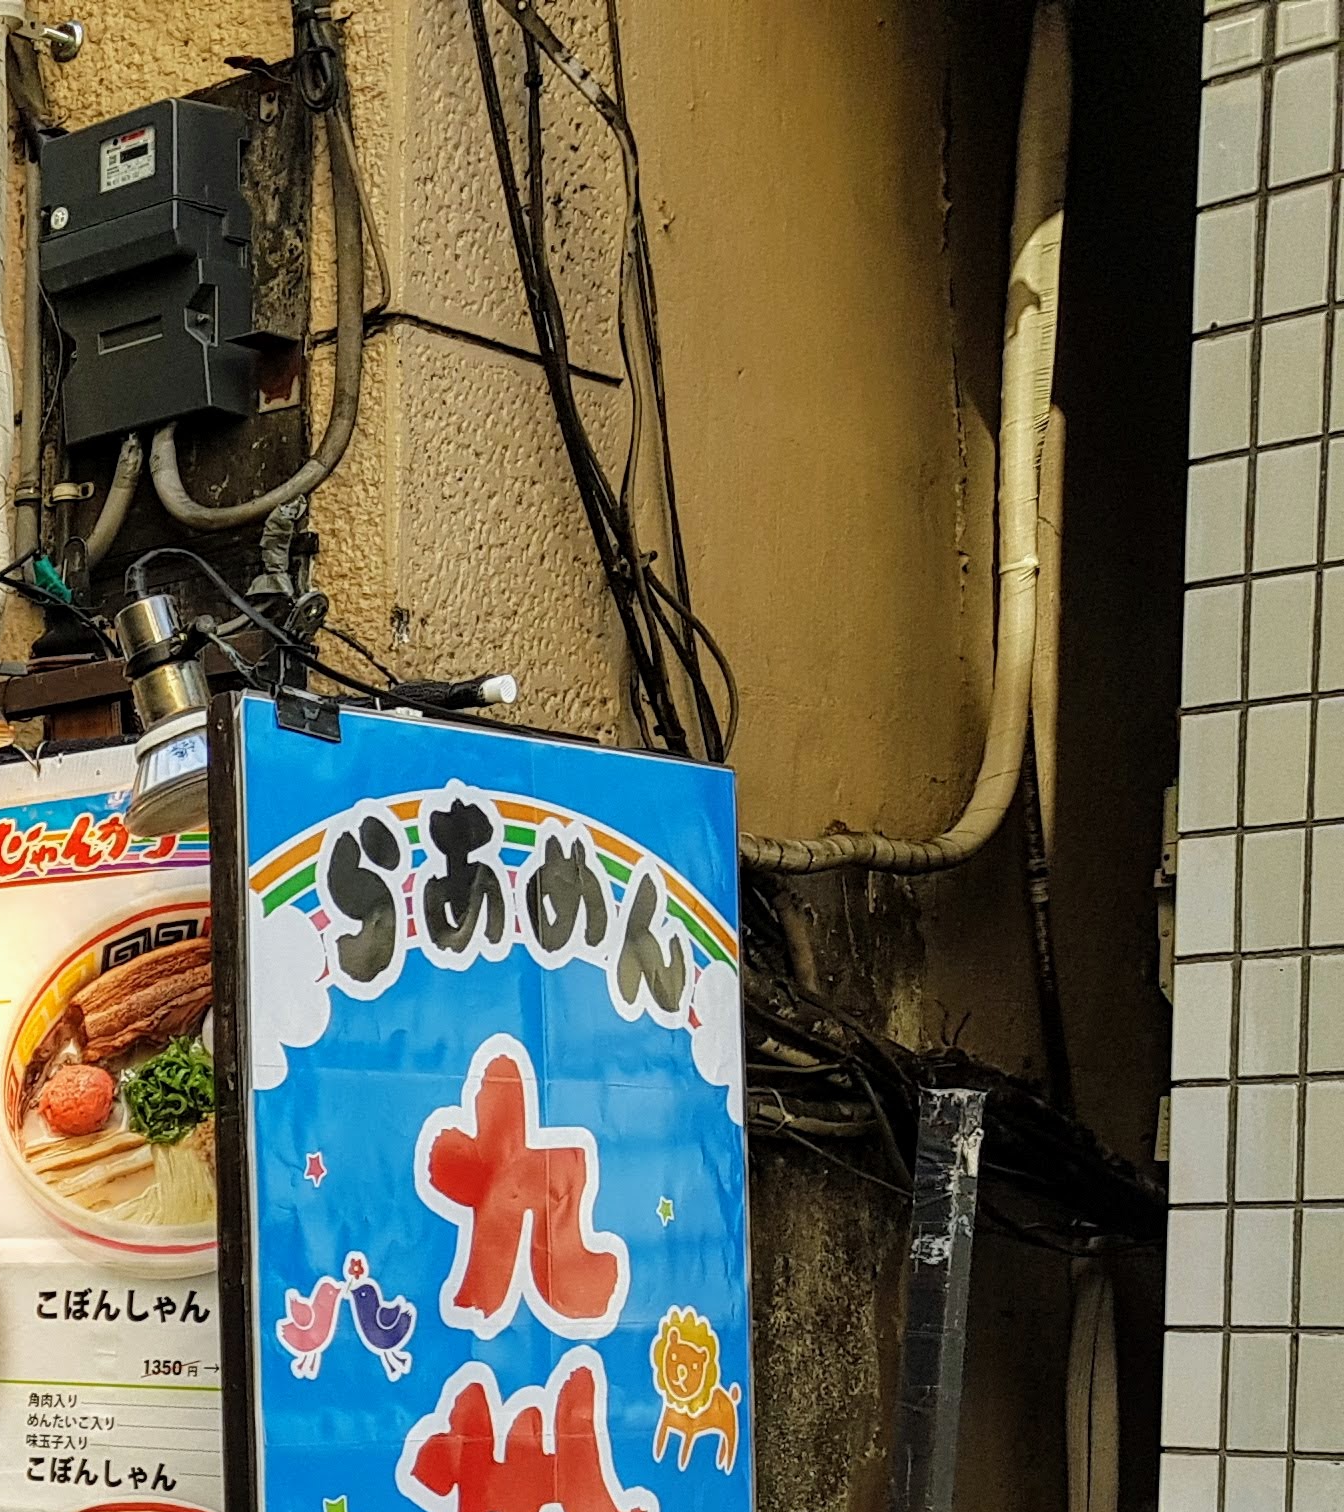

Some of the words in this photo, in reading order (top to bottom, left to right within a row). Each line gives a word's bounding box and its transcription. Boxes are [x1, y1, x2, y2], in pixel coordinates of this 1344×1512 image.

[324, 792, 690, 1016] らあめん
[35, 1288, 211, 1325] こぼんしゃん
[28, 1392, 78, 1409] 角肉入り
[27, 1413, 115, 1431] めんたいこ入り
[25, 1434, 89, 1451] 味玉子入り
[25, 1456, 177, 1491] こぼんしゃん
